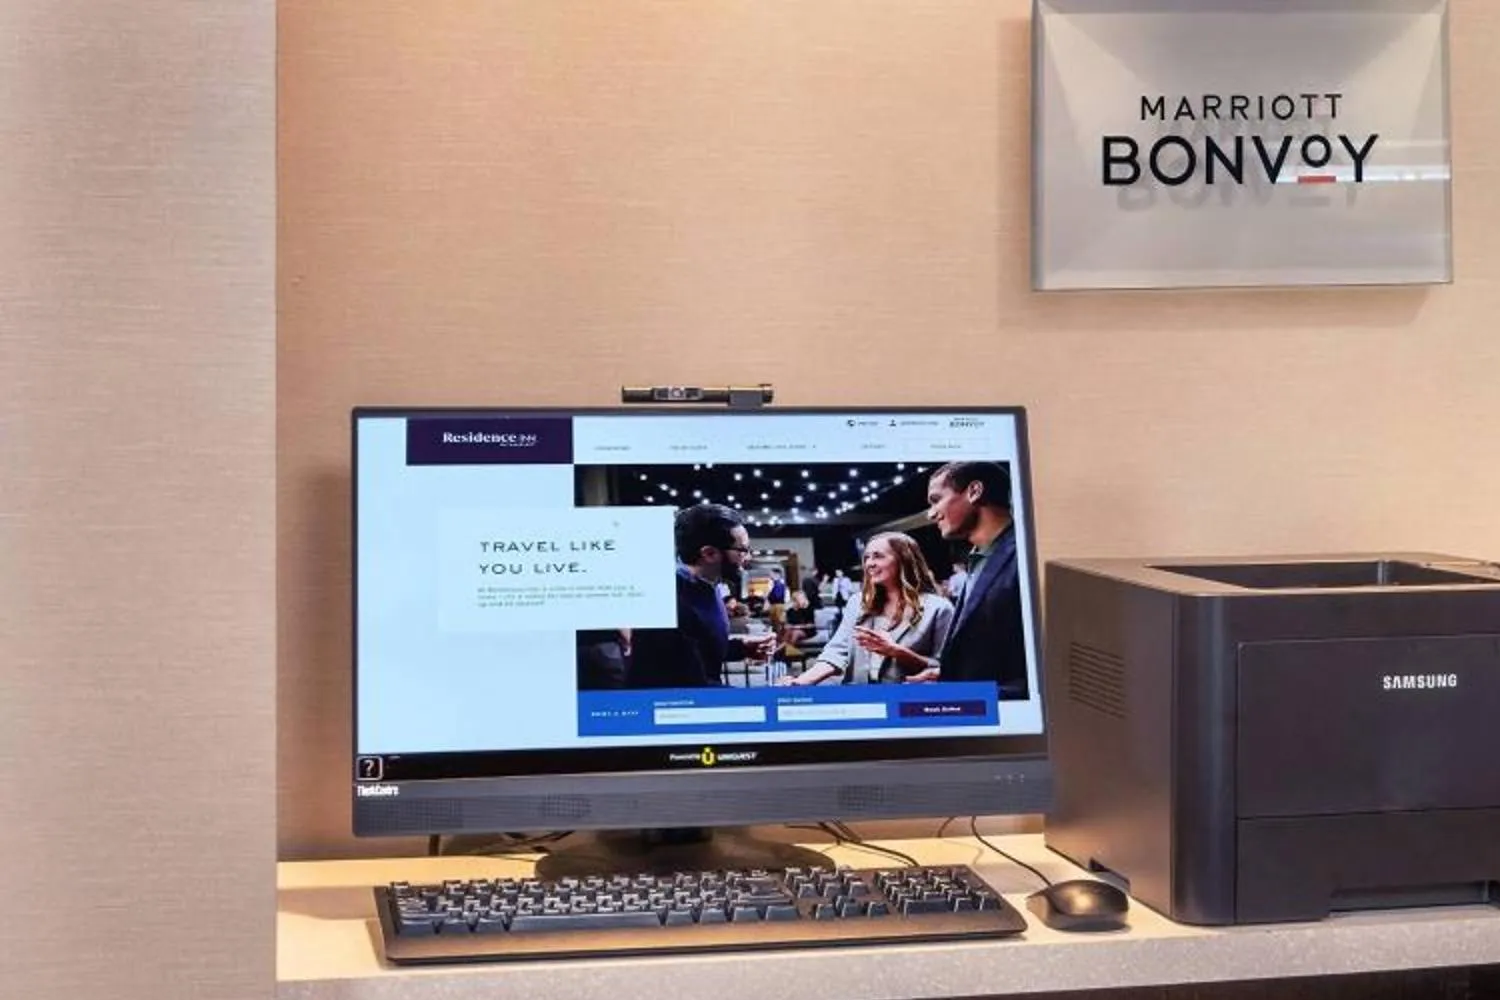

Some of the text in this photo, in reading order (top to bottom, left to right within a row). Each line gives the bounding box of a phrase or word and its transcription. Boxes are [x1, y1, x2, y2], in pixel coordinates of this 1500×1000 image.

[1140, 93, 1343, 121] MARRIOTT
[1102, 133, 1380, 186] BONVOY
[442, 431, 517, 444] Residence
[479, 539, 616, 553] TRAVEL LIKE
[478, 562, 588, 575] YOU LIVE.
[1383, 673, 1458, 690] SAMSUNG
